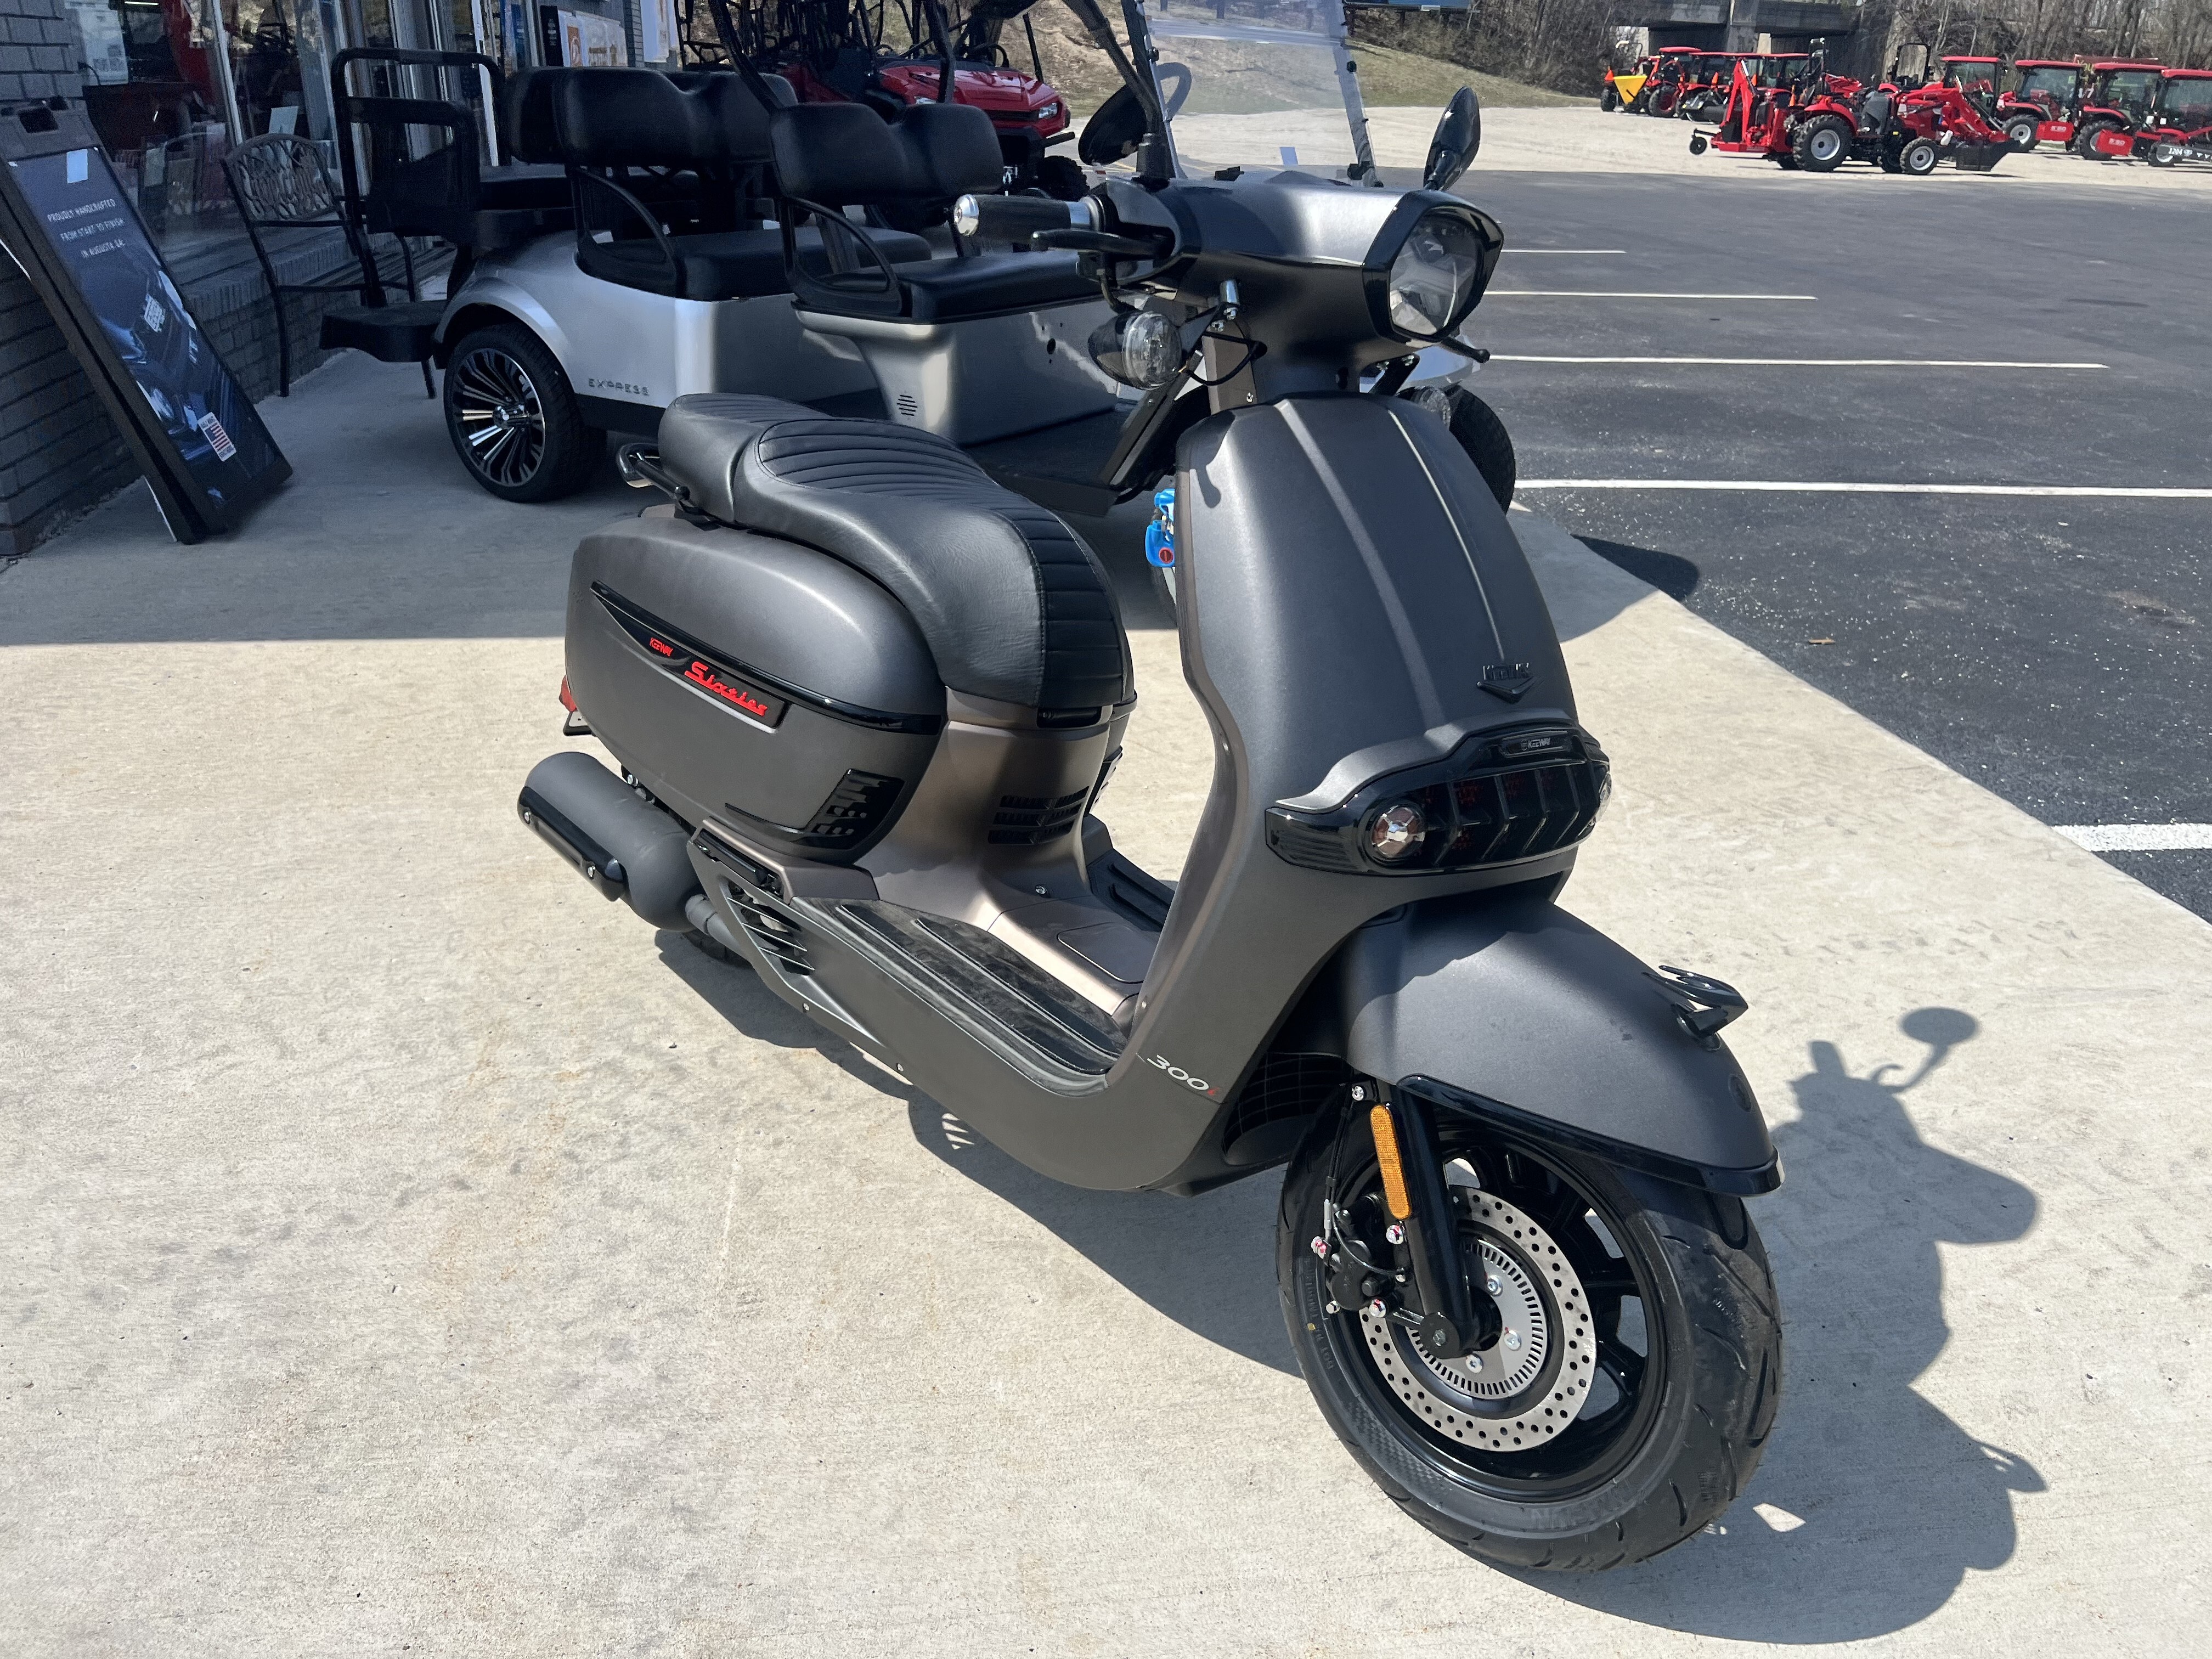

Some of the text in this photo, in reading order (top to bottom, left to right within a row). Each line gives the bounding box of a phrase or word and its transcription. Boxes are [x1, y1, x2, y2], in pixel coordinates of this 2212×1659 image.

[47, 198, 117, 222] PROUDLY HANDCRAFTED
[60, 230, 78, 242] FROM
[77, 224, 97, 238] START
[104, 217, 125, 231] FINISH
[588, 378, 650, 396] EXPRESS
[650, 637, 674, 657] KEEWAY
